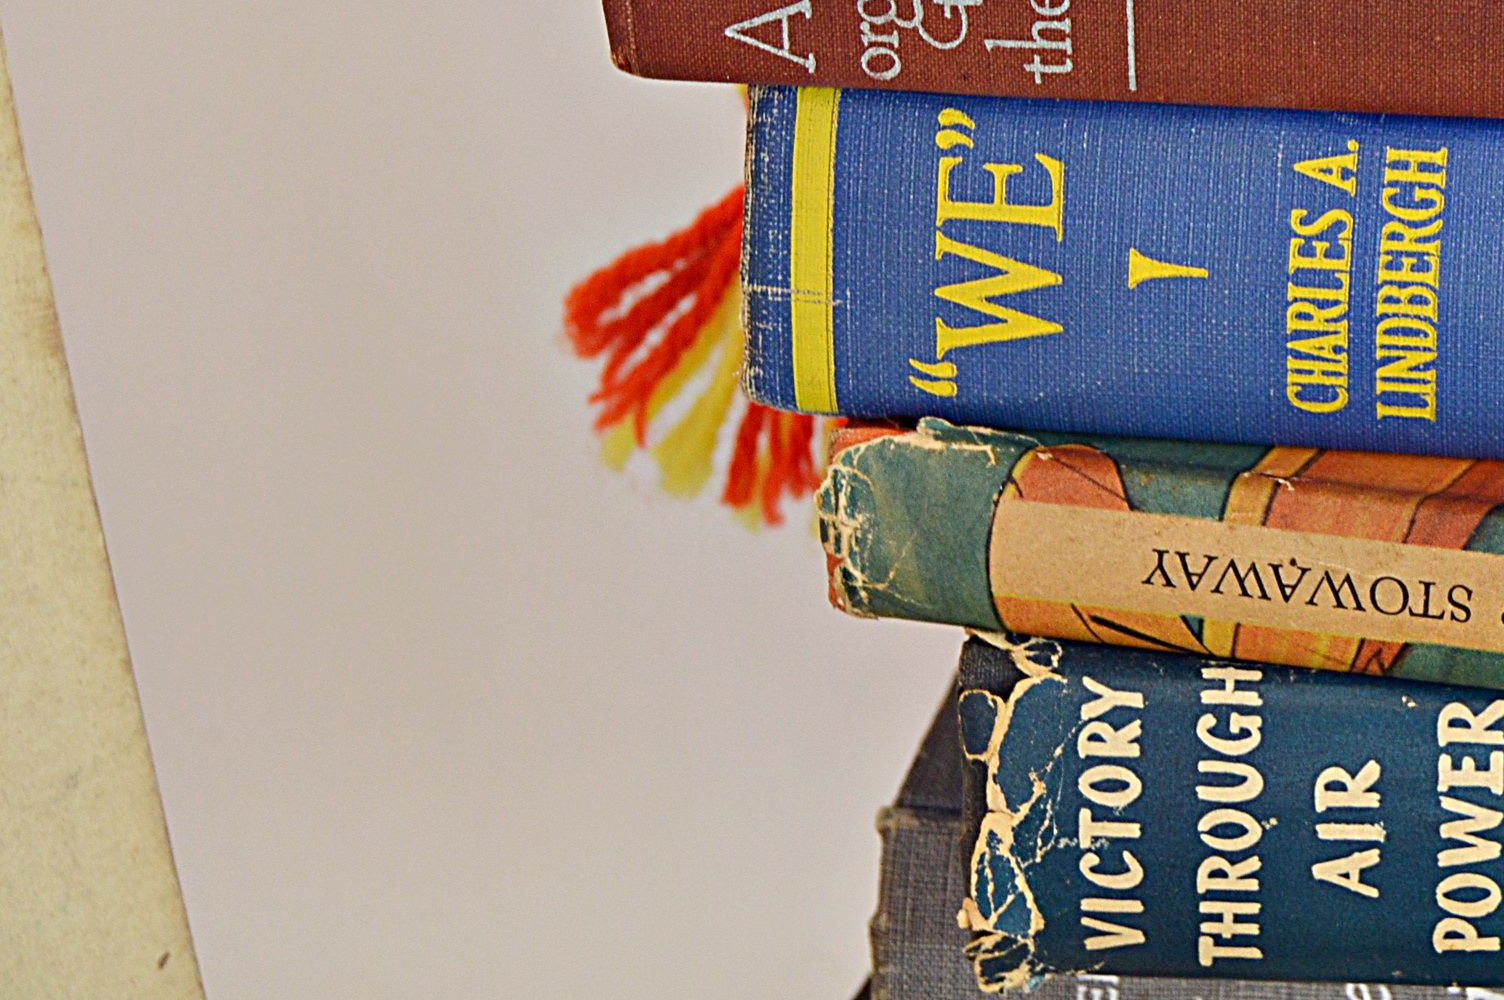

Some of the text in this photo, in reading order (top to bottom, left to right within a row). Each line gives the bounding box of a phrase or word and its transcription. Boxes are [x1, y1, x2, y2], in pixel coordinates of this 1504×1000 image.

[1286, 138, 1360, 413] CHARLES A.
[1375, 145, 1449, 423] LINDBERGH
[1142, 546, 1473, 624] STOWAWAY
[1077, 675, 1146, 950] VICTORY
[1196, 666, 1263, 966] THROUGH
[1311, 760, 1386, 898] AIR
